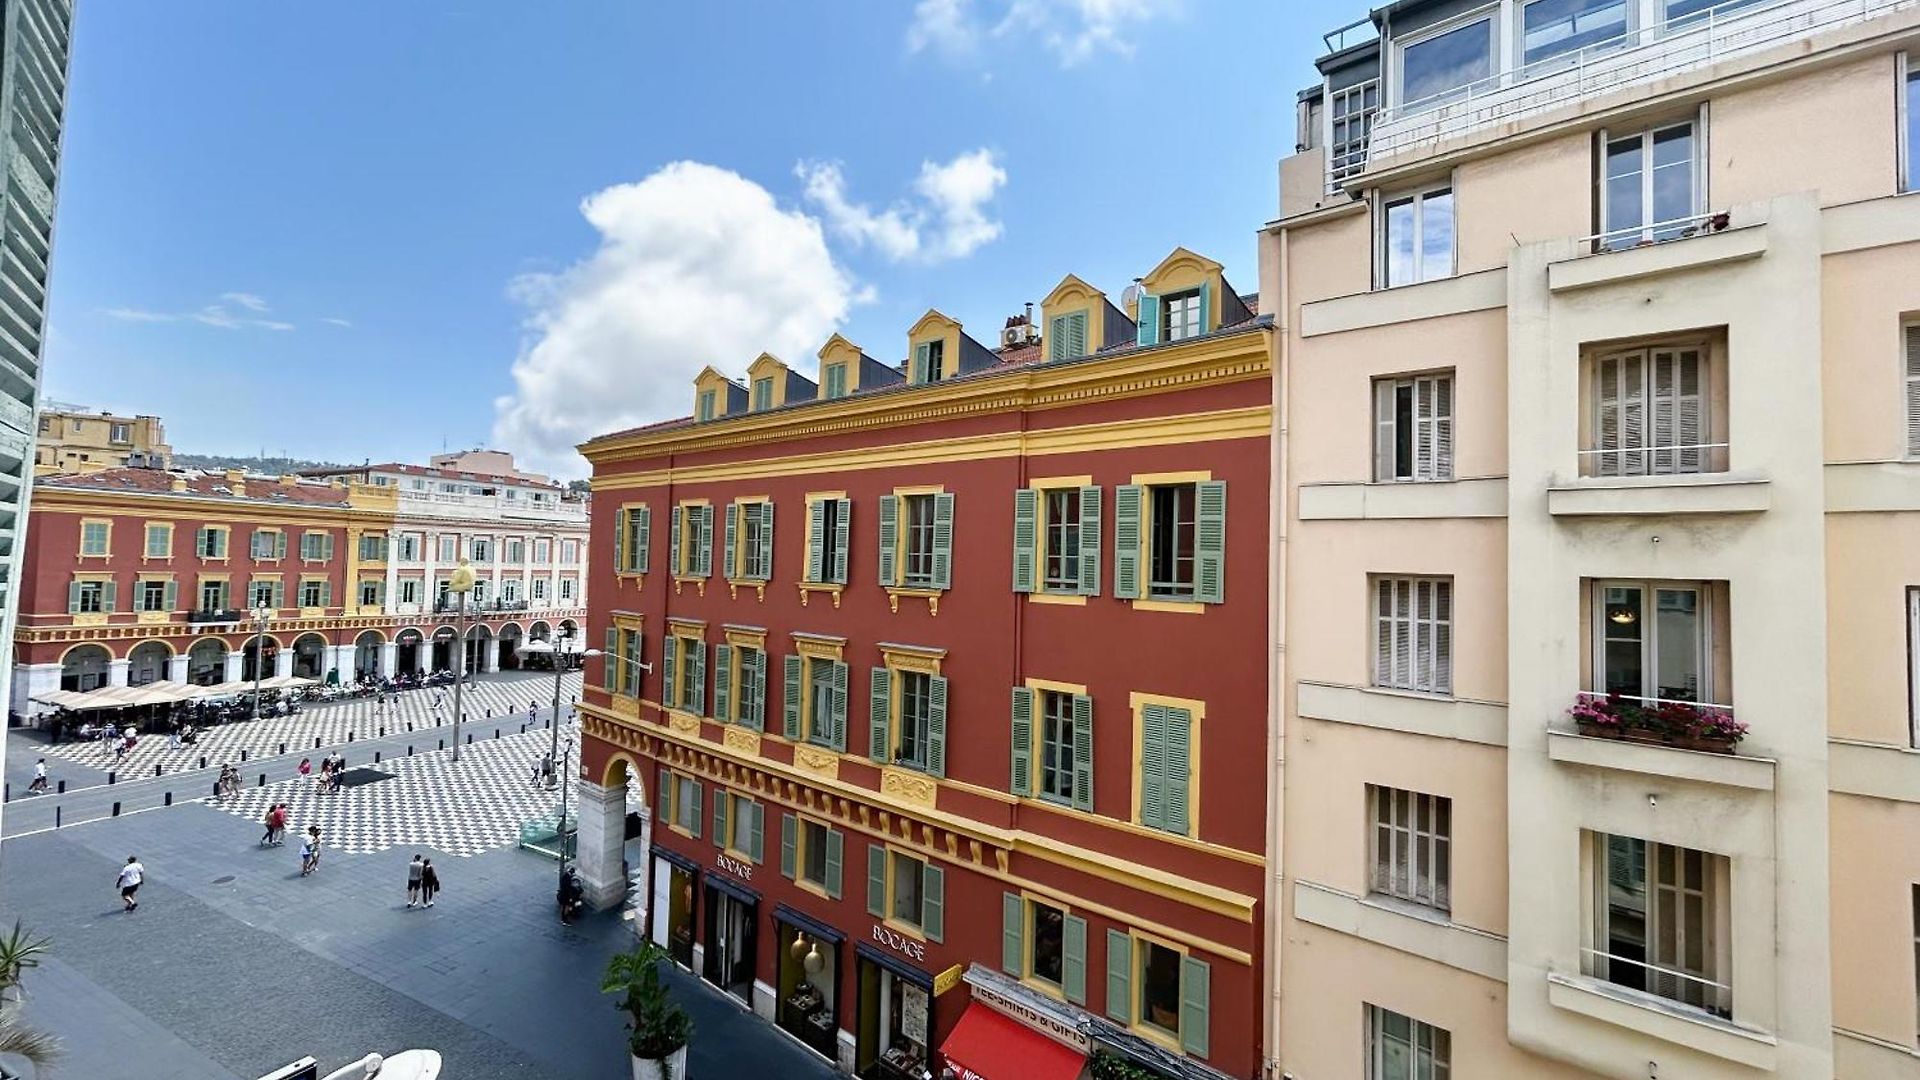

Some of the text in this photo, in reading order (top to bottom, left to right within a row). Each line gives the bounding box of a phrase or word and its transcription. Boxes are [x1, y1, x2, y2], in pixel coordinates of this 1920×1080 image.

[717, 854, 753, 881] BOCAGE
[873, 925, 926, 962] BOCAGE
[1040, 1016, 1048, 1027] &
[1052, 1021, 1086, 1046] GIFTS
[962, 1069, 985, 1080] NIC
